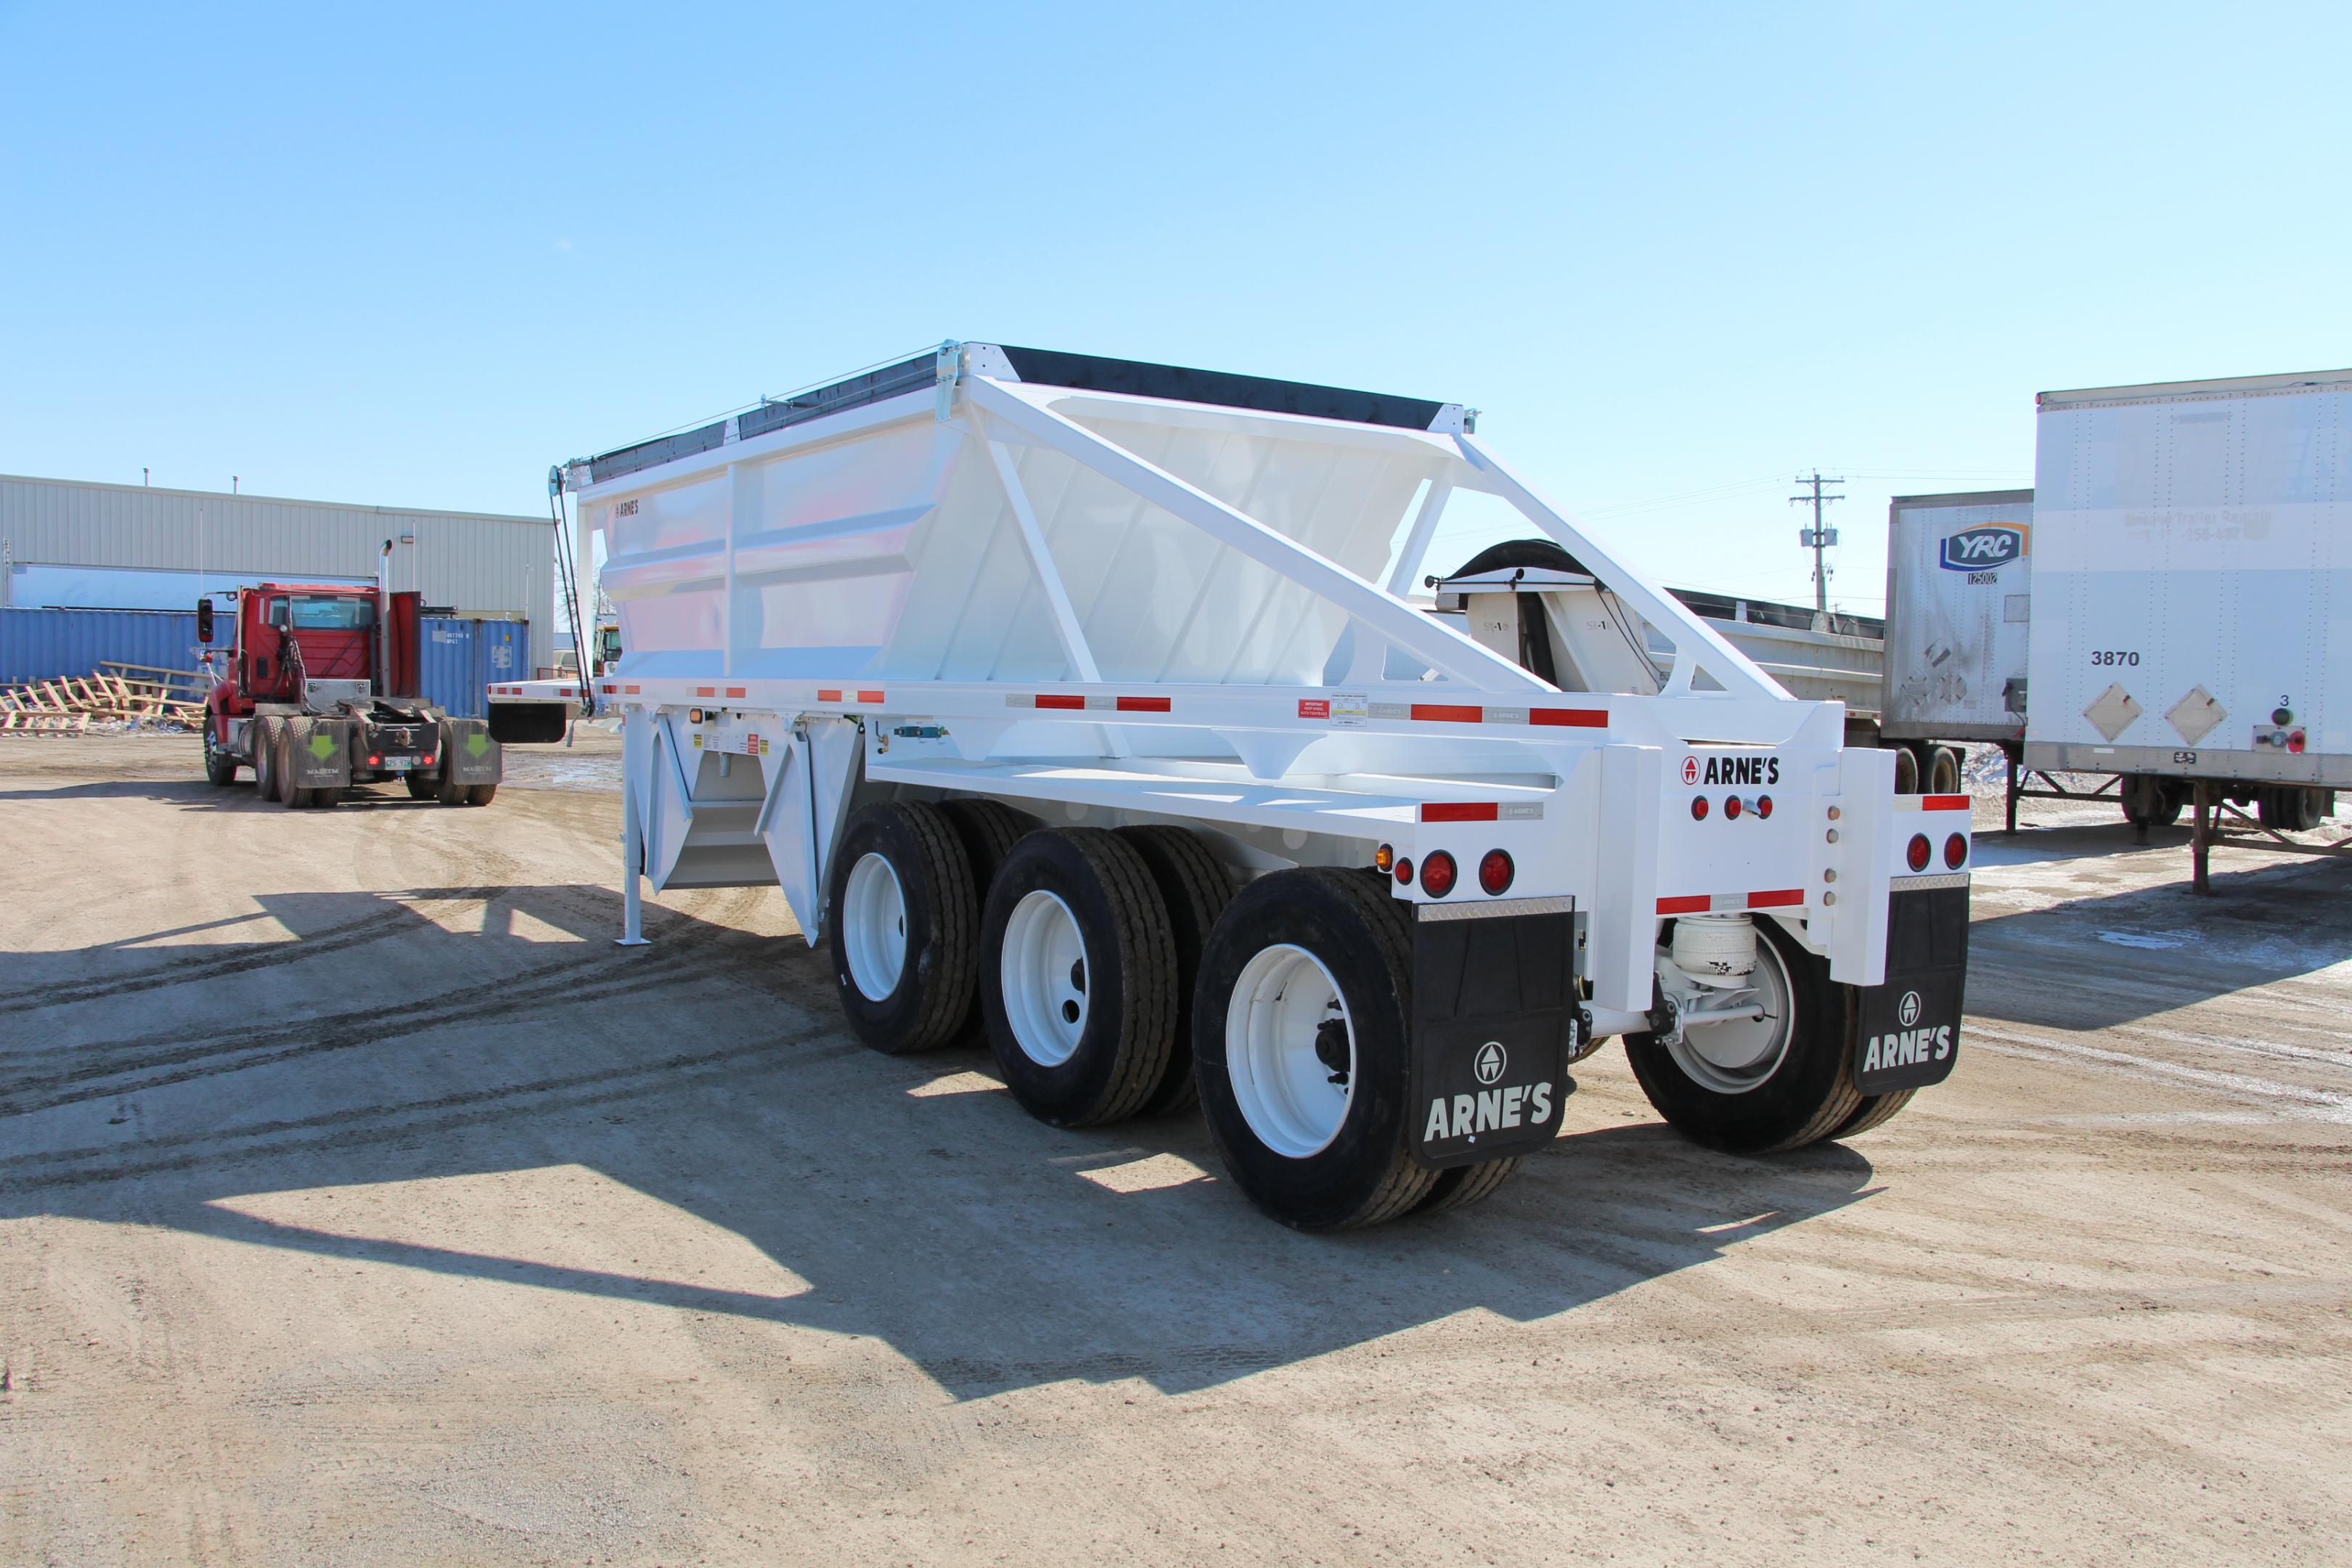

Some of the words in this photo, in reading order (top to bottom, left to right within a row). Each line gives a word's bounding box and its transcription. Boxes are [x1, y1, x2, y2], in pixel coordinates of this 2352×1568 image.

[620, 499, 638, 518] ARNE'S
[1958, 534, 2012, 558] YRC
[1968, 573, 1997, 584] 125002
[2091, 651, 2139, 666] 3870
[2279, 695, 2289, 706] 3
[1704, 757, 1779, 785] ARNE'S
[1863, 1025, 1951, 1072] ARNE'S
[1423, 1082, 1552, 1142] ARNE'S
